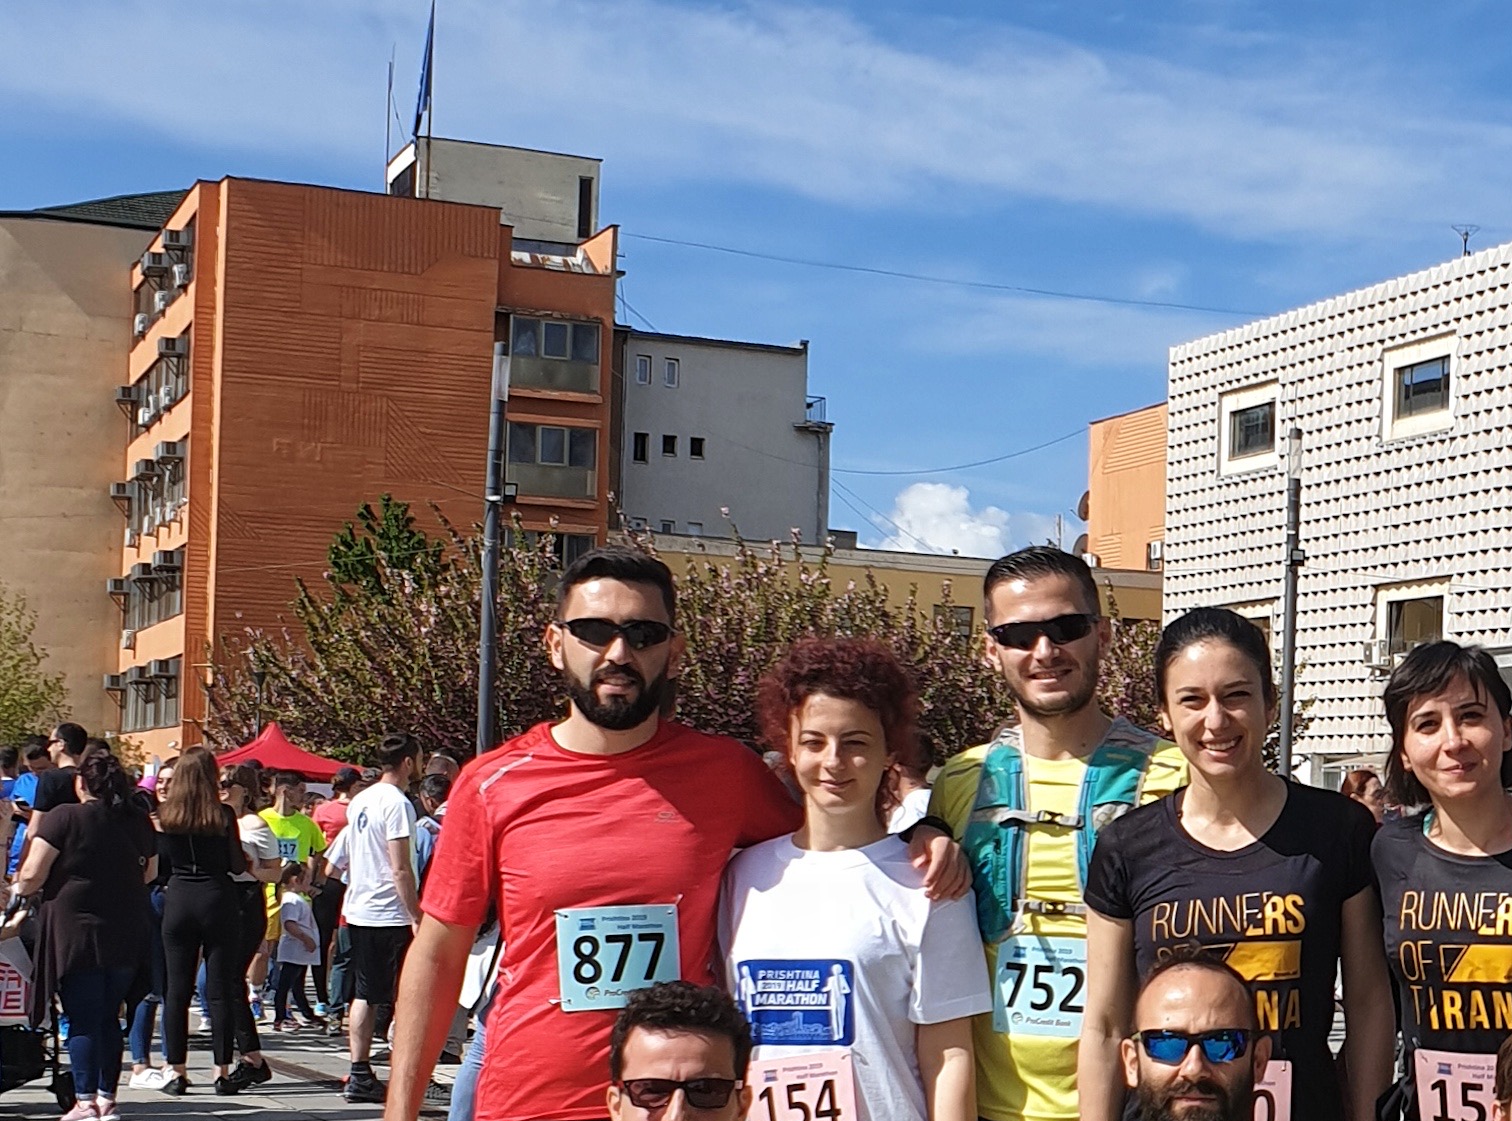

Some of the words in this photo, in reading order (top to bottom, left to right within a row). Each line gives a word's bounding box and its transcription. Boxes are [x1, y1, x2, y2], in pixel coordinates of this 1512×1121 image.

[1152, 891, 1305, 942] RUNNERS
[573, 932, 665, 985] 877
[758, 970, 821, 980] PRISHTINA
[1400, 940, 1433, 981] OF
[755, 993, 828, 1005] MARATHON
[786, 980, 820, 991] HALF
[1006, 962, 1084, 1013] 752
